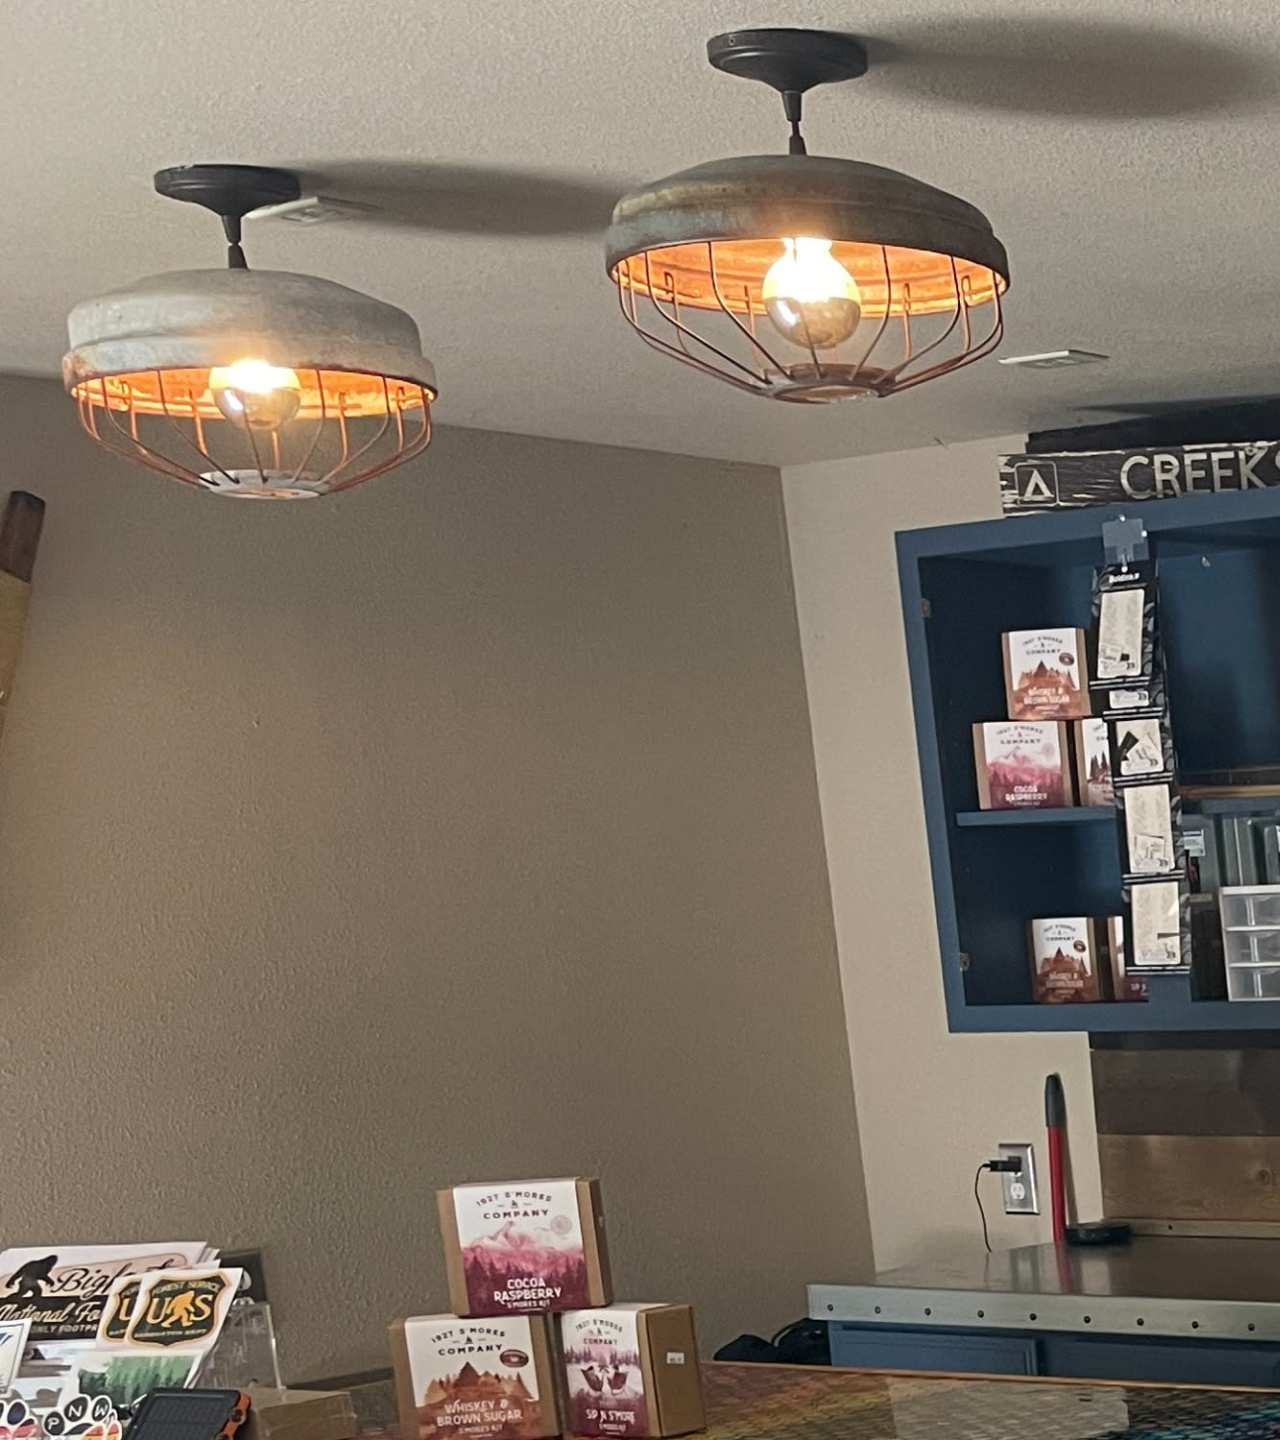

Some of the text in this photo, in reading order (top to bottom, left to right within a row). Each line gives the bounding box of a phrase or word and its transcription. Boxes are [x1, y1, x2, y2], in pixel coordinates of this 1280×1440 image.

[505, 1191, 552, 1202] S'MORES
[483, 1209, 549, 1219] COMPANY
[507, 1278, 546, 1289] COCOA
[494, 1287, 562, 1304] RASPBERRY
[459, 1328, 506, 1337] S'MORES
[438, 1344, 503, 1356] COMPANY
[444, 1400, 496, 1414] WHISKEY
[436, 1409, 523, 1427] BROWN SUGAR
